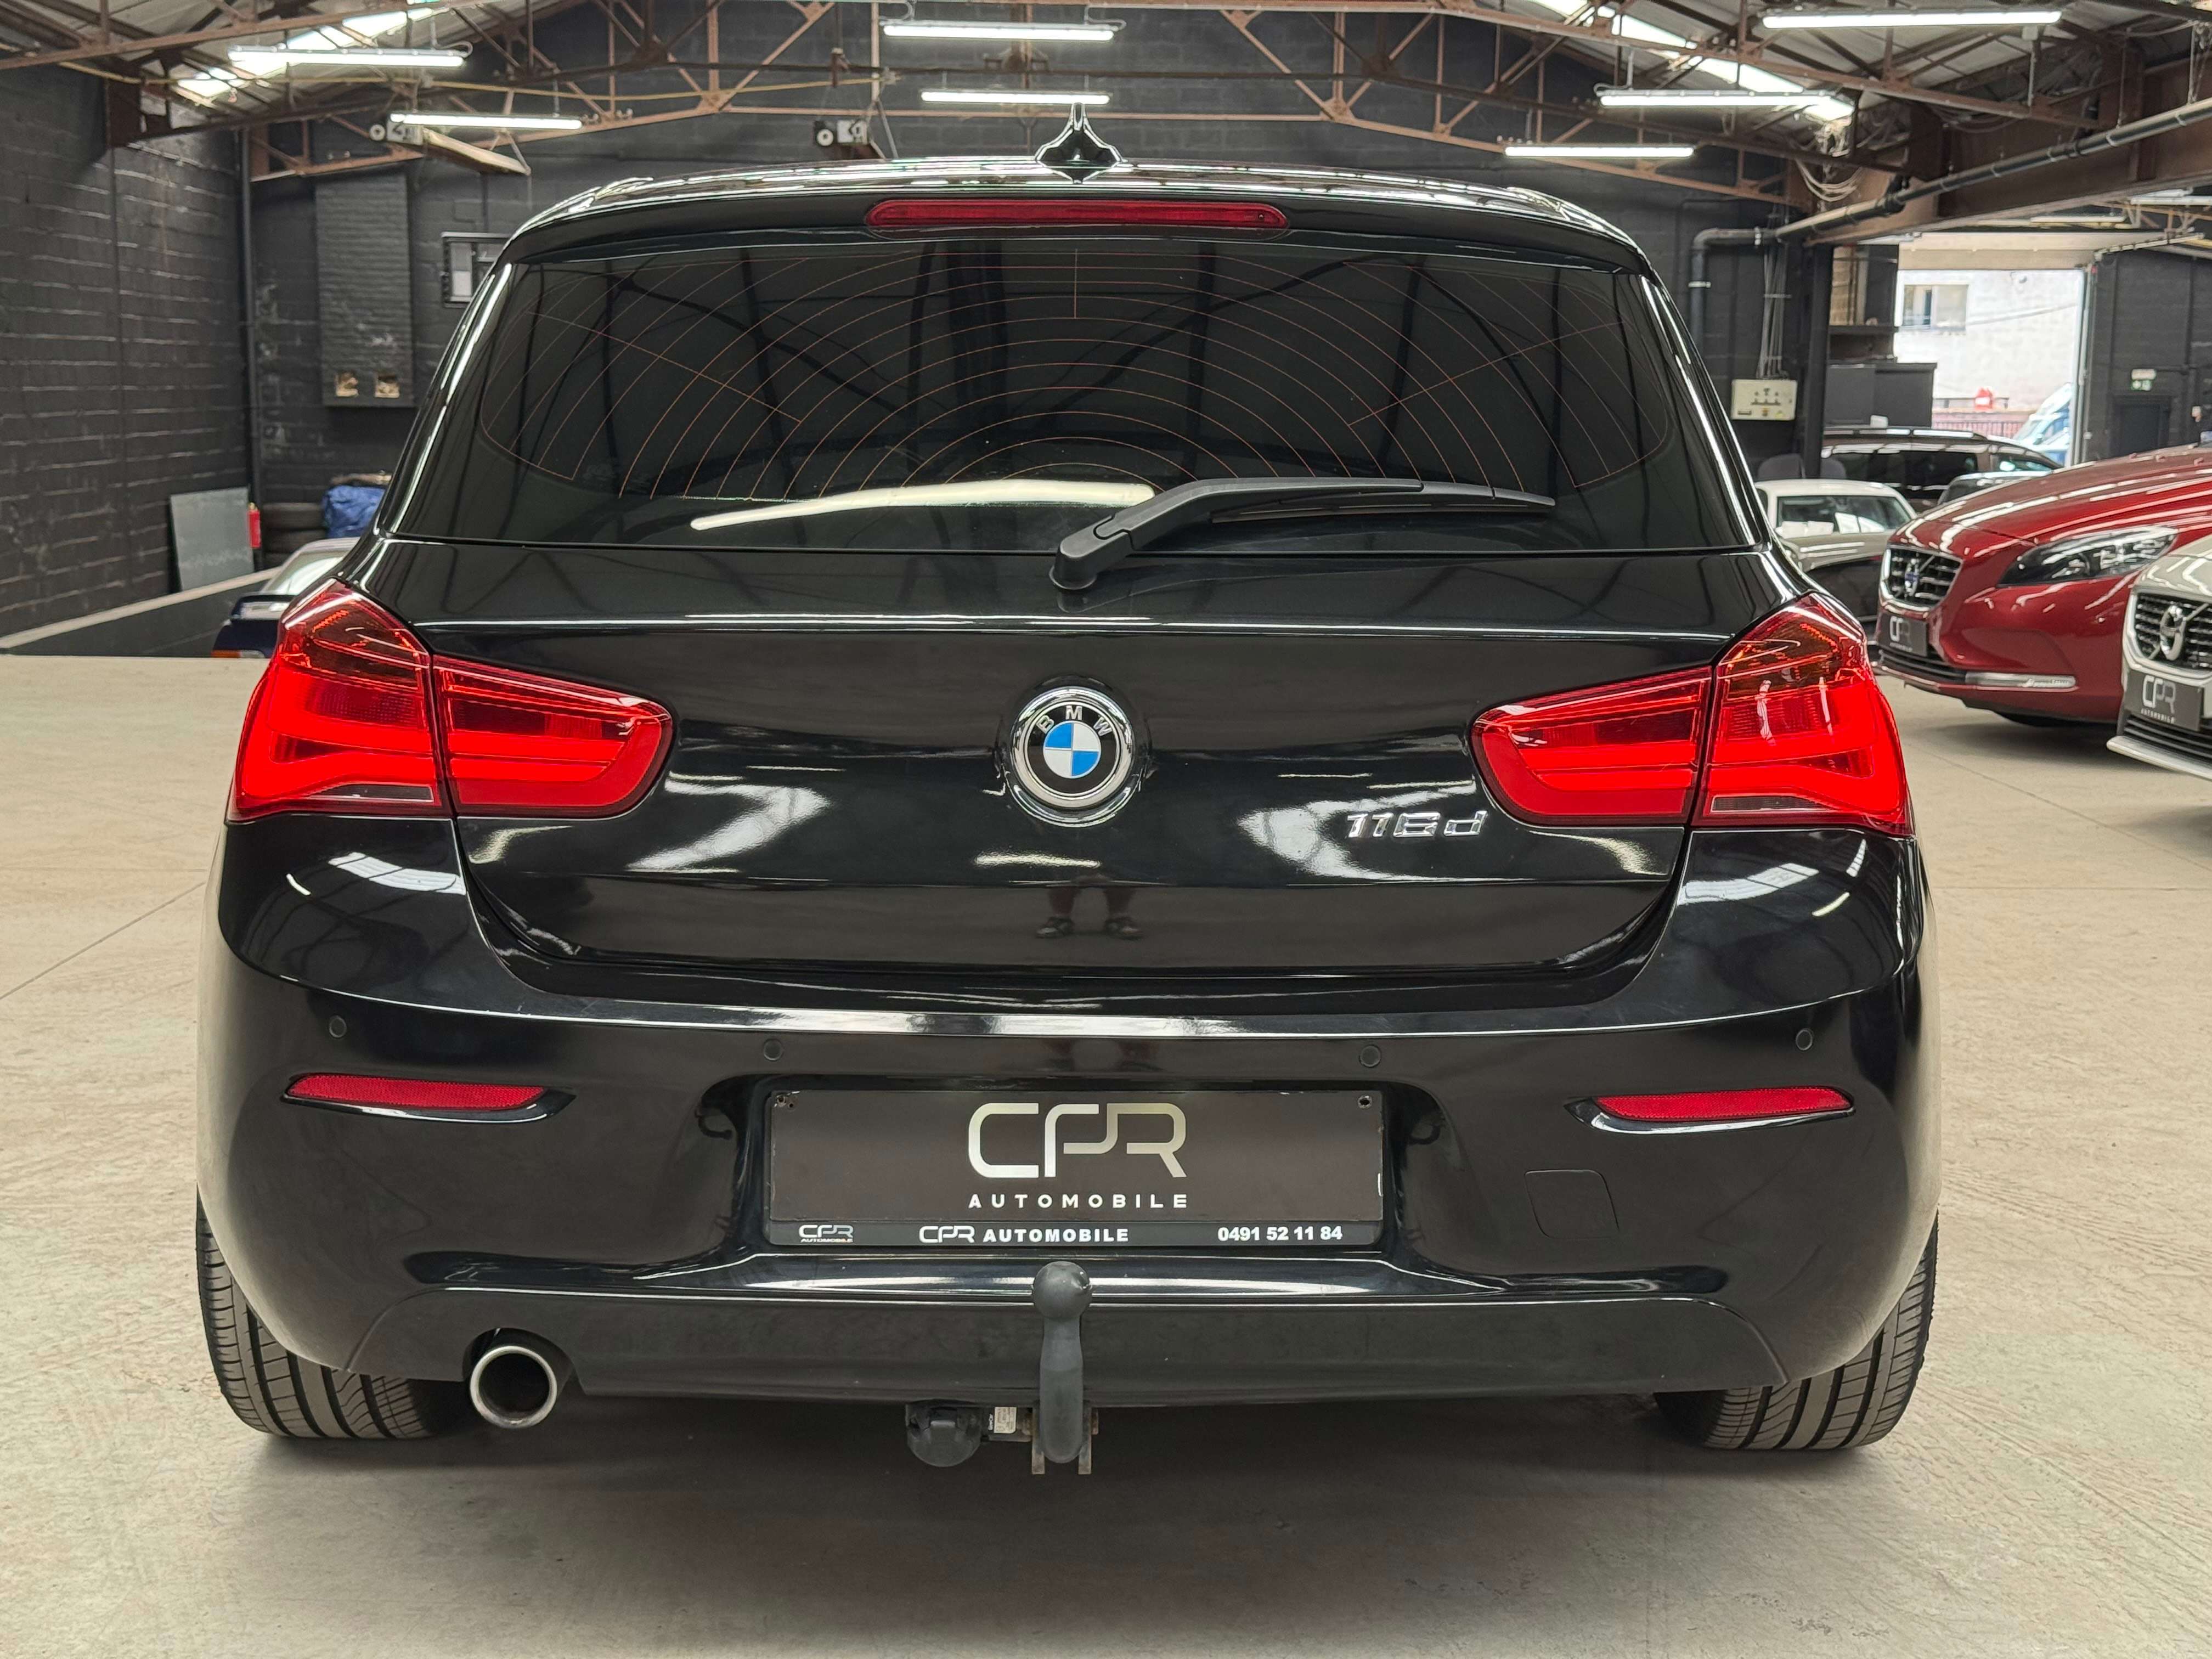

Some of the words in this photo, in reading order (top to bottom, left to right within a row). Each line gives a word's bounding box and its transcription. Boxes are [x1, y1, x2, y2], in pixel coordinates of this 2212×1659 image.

[2142, 675, 2176, 714] CPR
[1036, 705, 1113, 736] BMW
[1347, 810, 1488, 838] 116d
[968, 1103, 1187, 1178] CPR
[968, 1193, 1187, 1209] AUTOMOBILE
[799, 1224, 854, 1238] CPR
[918, 1226, 975, 1243] CPR
[983, 1228, 1129, 1243] AUTOMOBILE
[1217, 1226, 1260, 1242] 0491
[1266, 1226, 1289, 1241] 52
[1294, 1226, 1314, 1240] 11
[1320, 1226, 1343, 1240] 84
